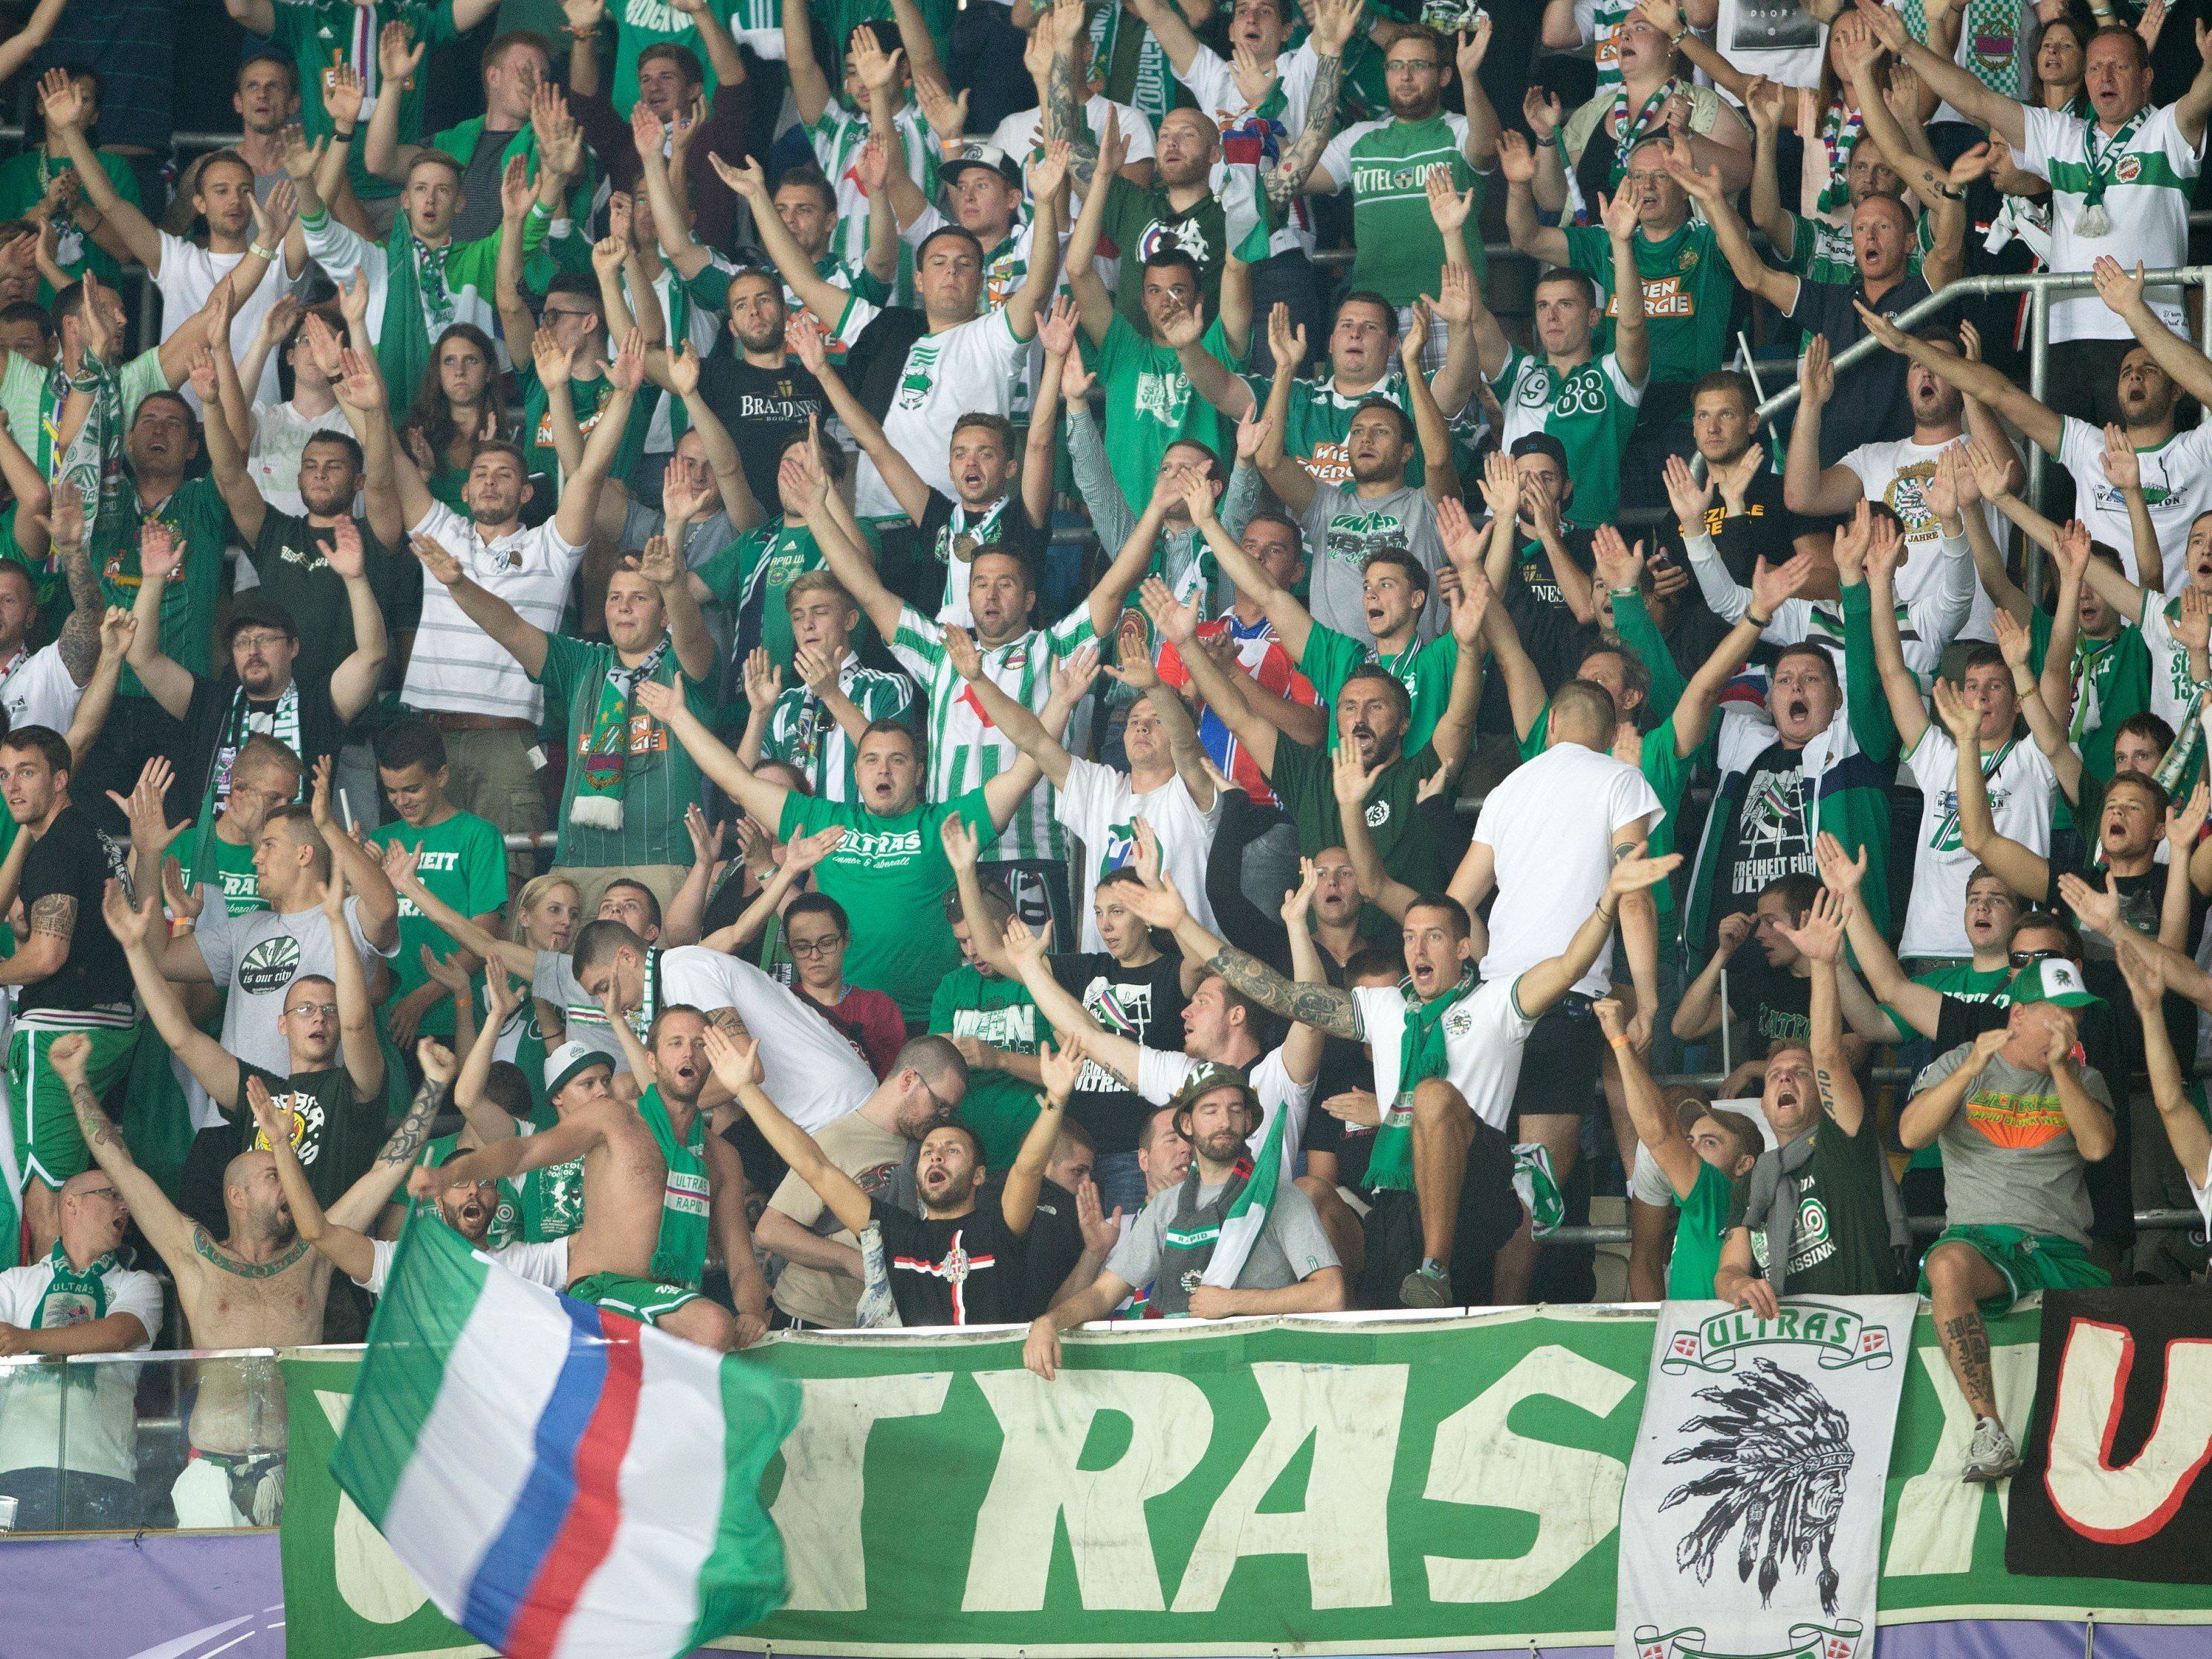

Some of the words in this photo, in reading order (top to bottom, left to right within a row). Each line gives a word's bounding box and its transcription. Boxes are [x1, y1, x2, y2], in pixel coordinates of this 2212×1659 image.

[1353, 166, 1394, 195] ÜTTEL
[1610, 296, 1689, 314] ERGIE
[1316, 446, 1349, 462] WIE
[1908, 531, 1939, 544] JAHRE
[770, 556, 792, 566] APID
[1733, 856, 1788, 879] FREIHEIT
[1190, 1061, 1215, 1087] 12
[676, 1175, 708, 1193] ULTRAS
[676, 1197, 704, 1213] RAPID
[1178, 1232, 1208, 1244] RAPID
[53, 1281, 94, 1294] ULTRAS
[1707, 1308, 1852, 1348] ULTRAS
